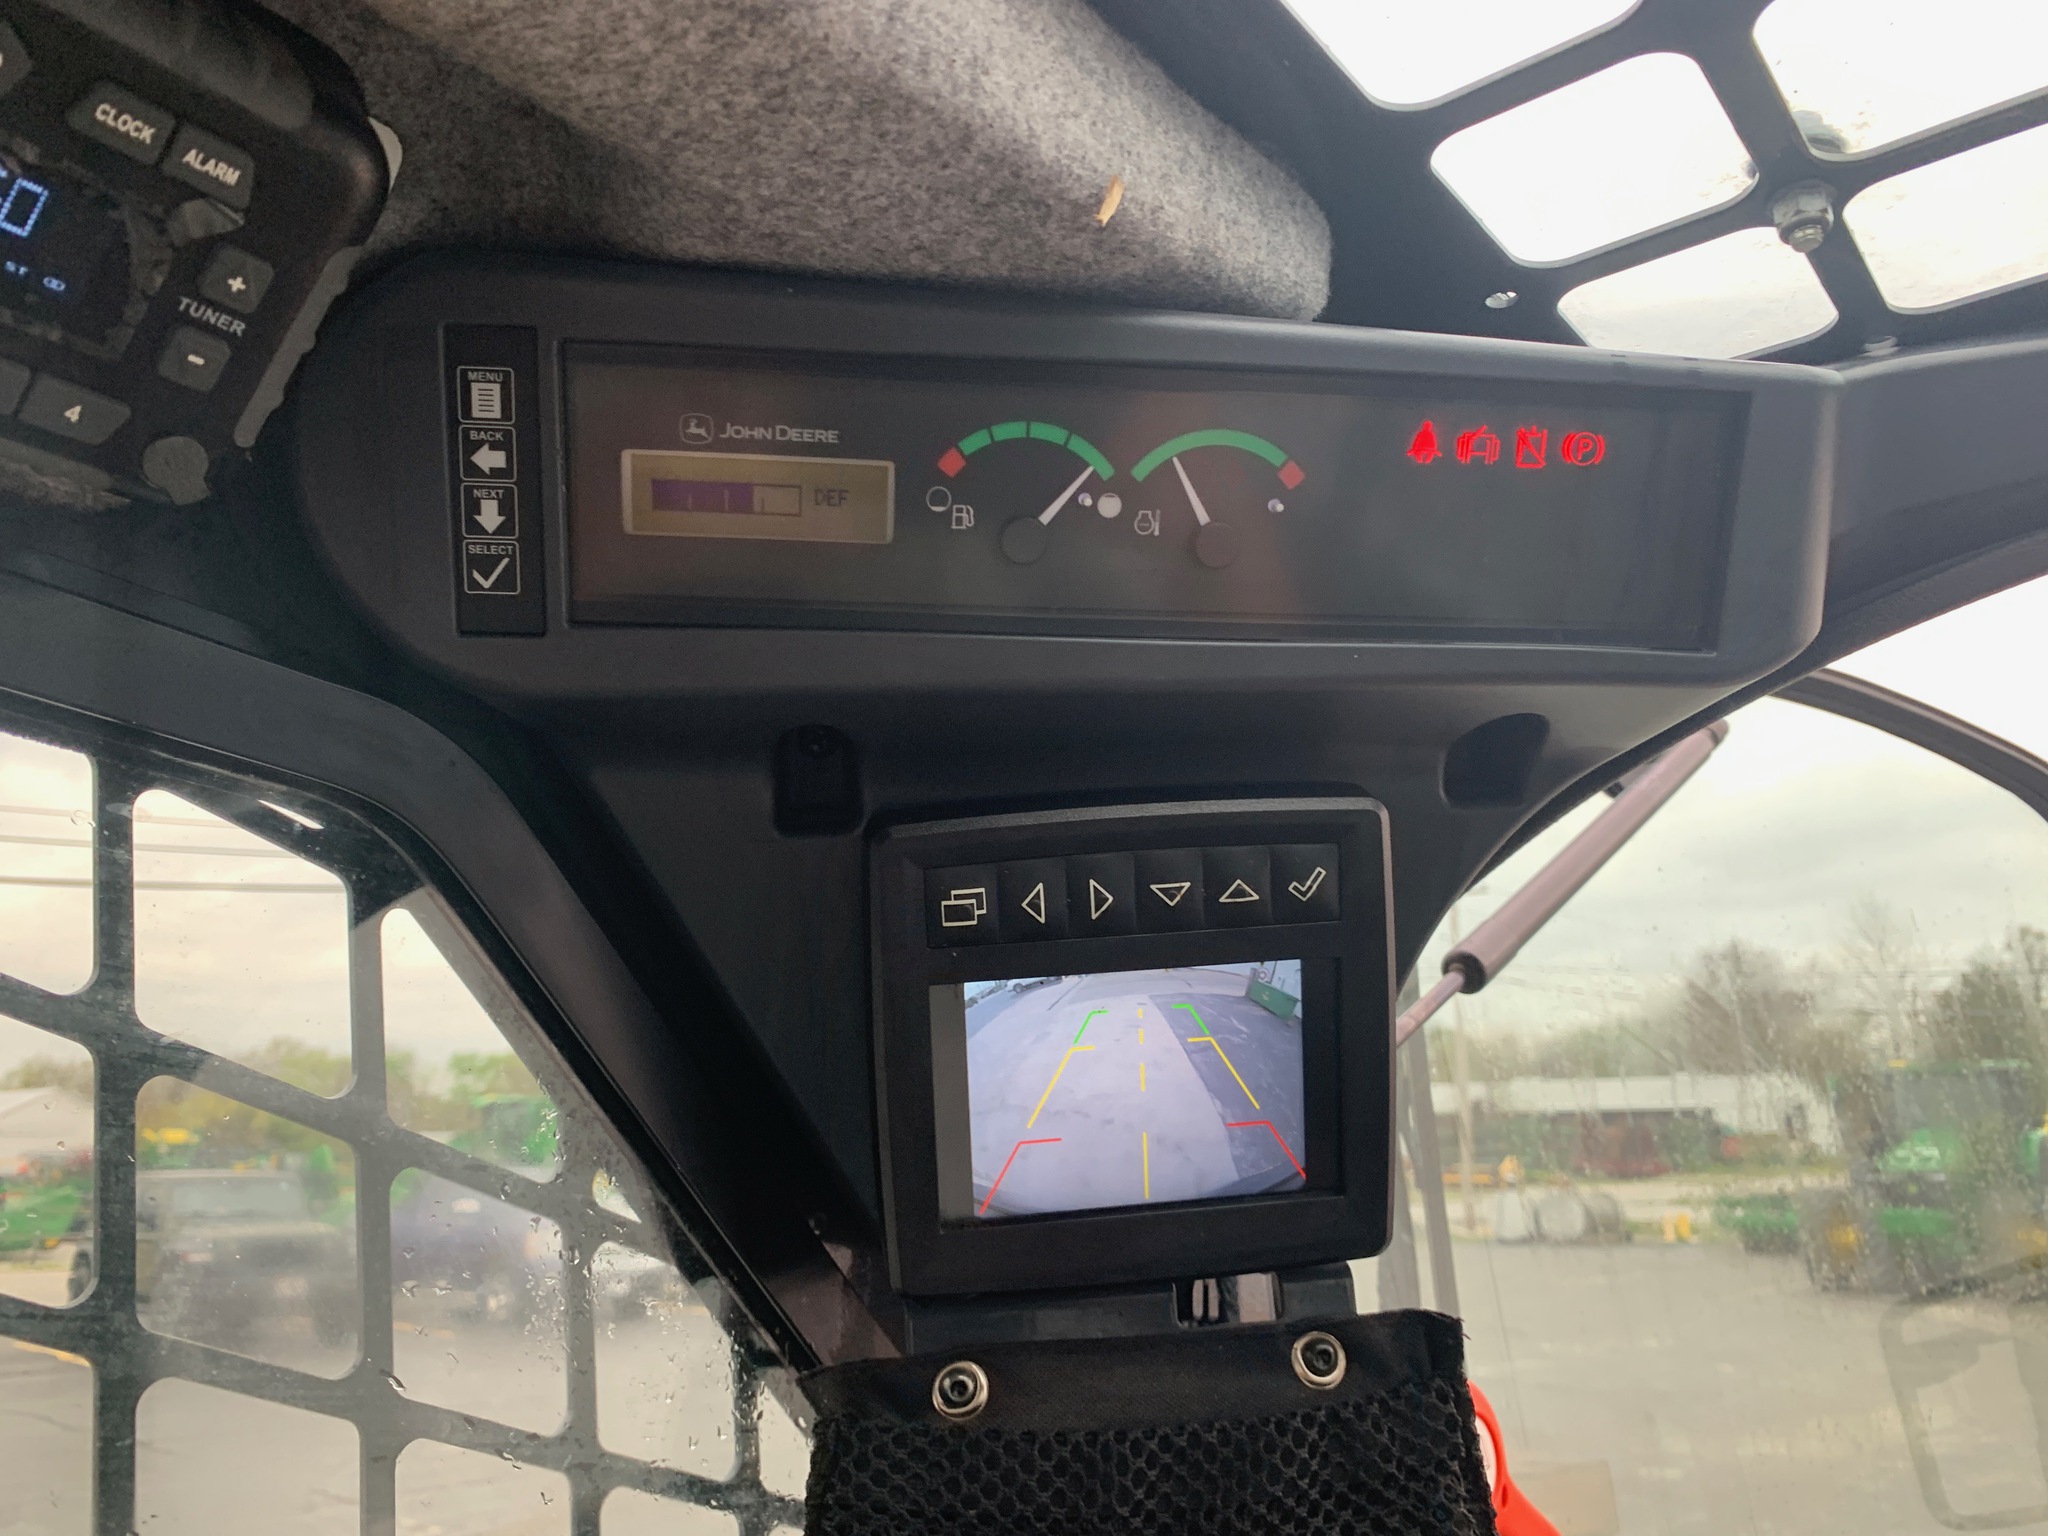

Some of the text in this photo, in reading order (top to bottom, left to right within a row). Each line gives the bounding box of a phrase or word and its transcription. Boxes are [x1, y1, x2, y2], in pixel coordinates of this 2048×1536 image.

[95, 103, 156, 145] CLOCK
[182, 148, 241, 187] ALARM
[179, 296, 246, 337] TUNER
[467, 371, 504, 382] MENU
[64, 405, 82, 423] 4
[469, 430, 504, 441] BACK
[720, 422, 840, 444] JOHN DEERE
[473, 488, 504, 499] NEXT
[814, 488, 849, 507] DEF
[467, 544, 514, 555] SELECT
